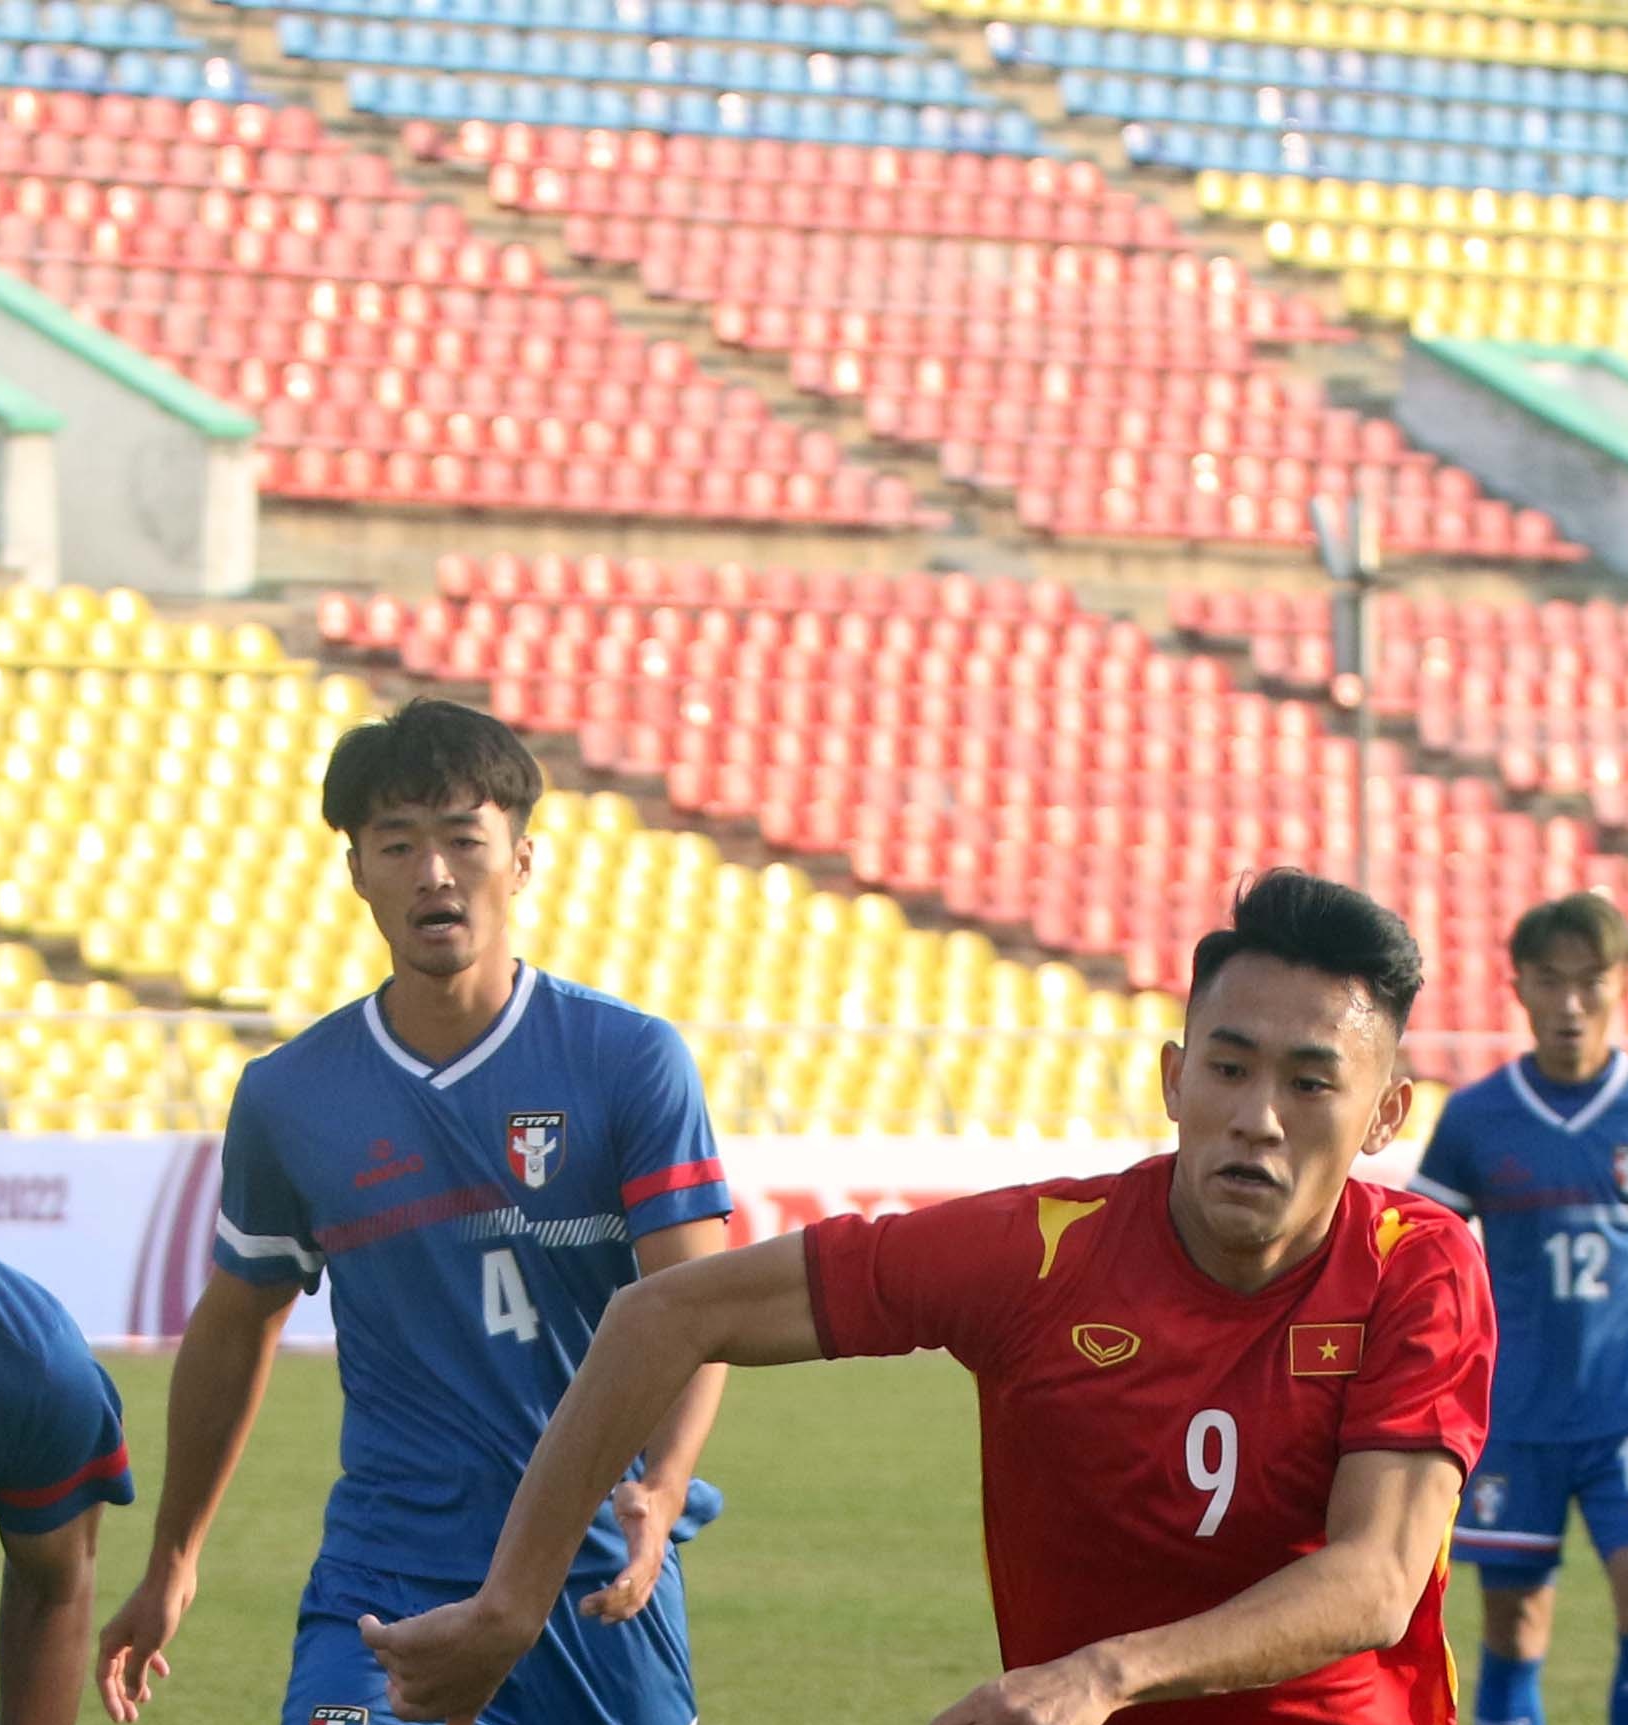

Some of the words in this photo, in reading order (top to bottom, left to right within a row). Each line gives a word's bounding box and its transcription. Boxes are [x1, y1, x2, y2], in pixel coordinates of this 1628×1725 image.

[512, 1115, 560, 1127] CTFA
[482, 1248, 540, 1342] 4
[1543, 1232, 1609, 1299] 12
[1185, 1408, 1238, 1536] 9
[314, 1709, 362, 1720] CTFA
